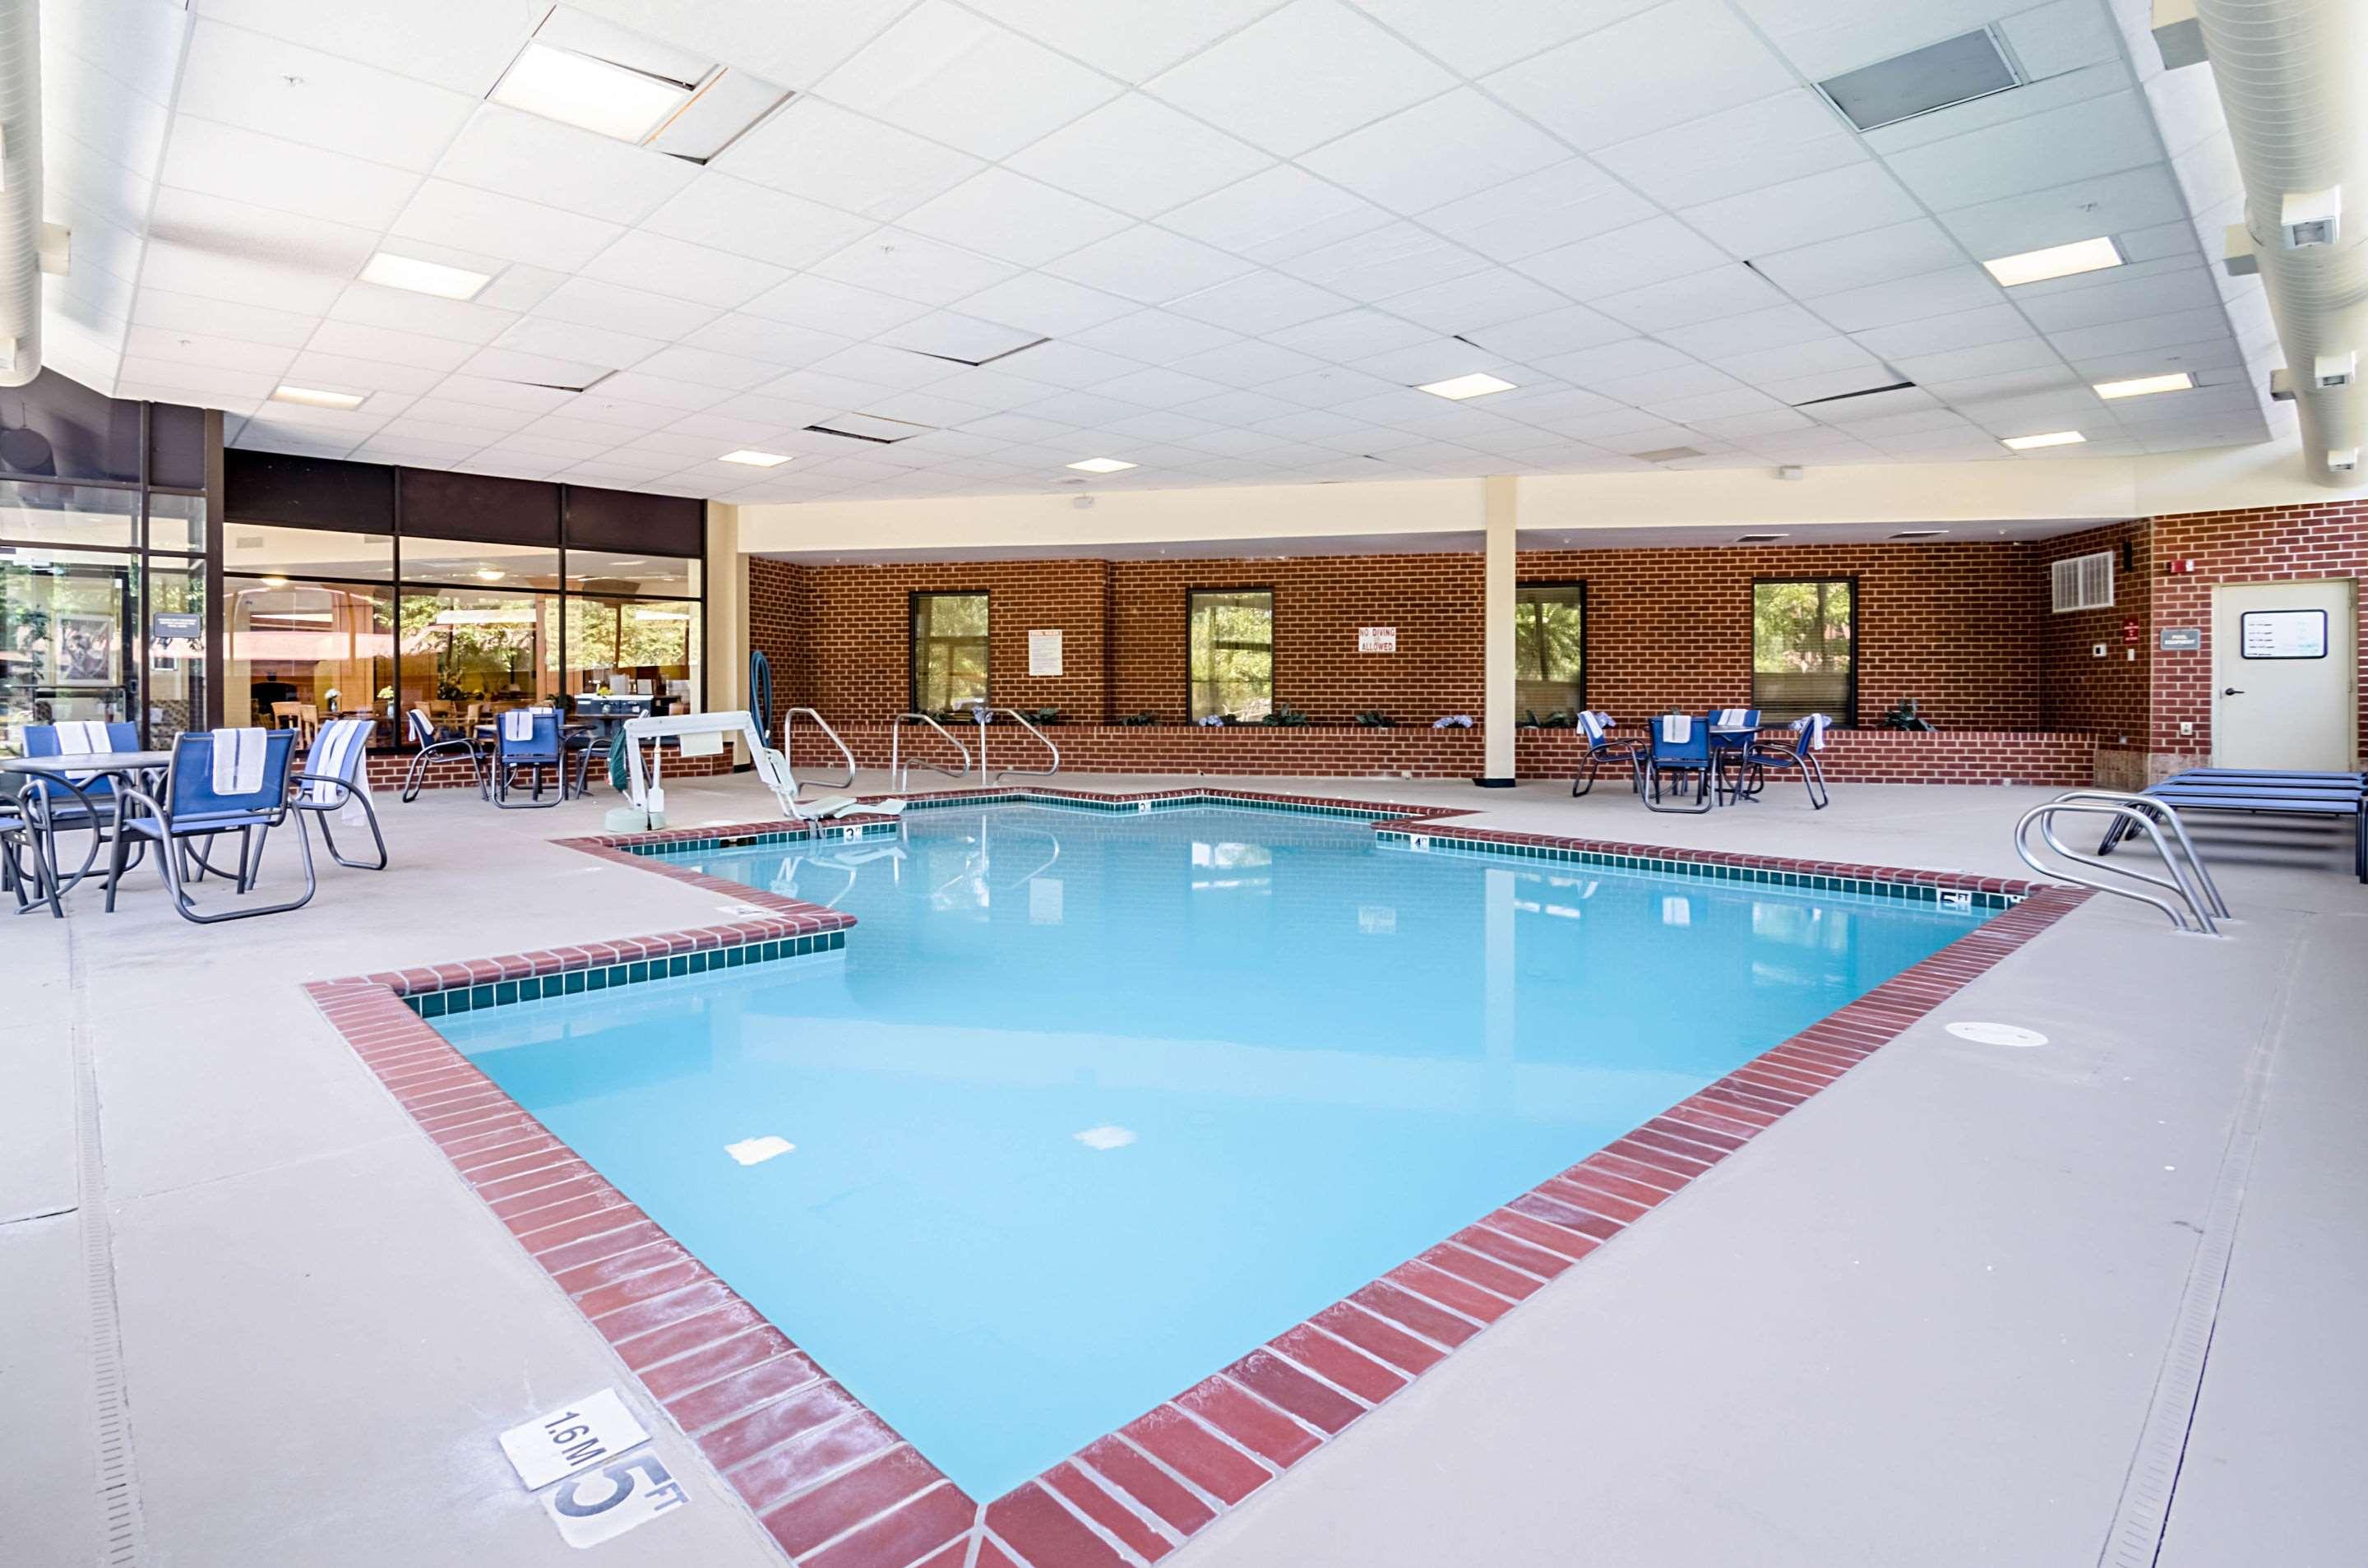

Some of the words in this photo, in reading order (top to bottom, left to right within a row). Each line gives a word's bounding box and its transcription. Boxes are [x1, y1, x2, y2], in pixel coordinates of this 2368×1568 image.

[1360, 628, 1368, 636] NO
[1372, 628, 1394, 636] DIVING
[1362, 642, 1392, 650] ALLOWED
[1958, 893, 1969, 901] FT
[554, 1455, 673, 1518] 5
[645, 1482, 690, 1511] FT
